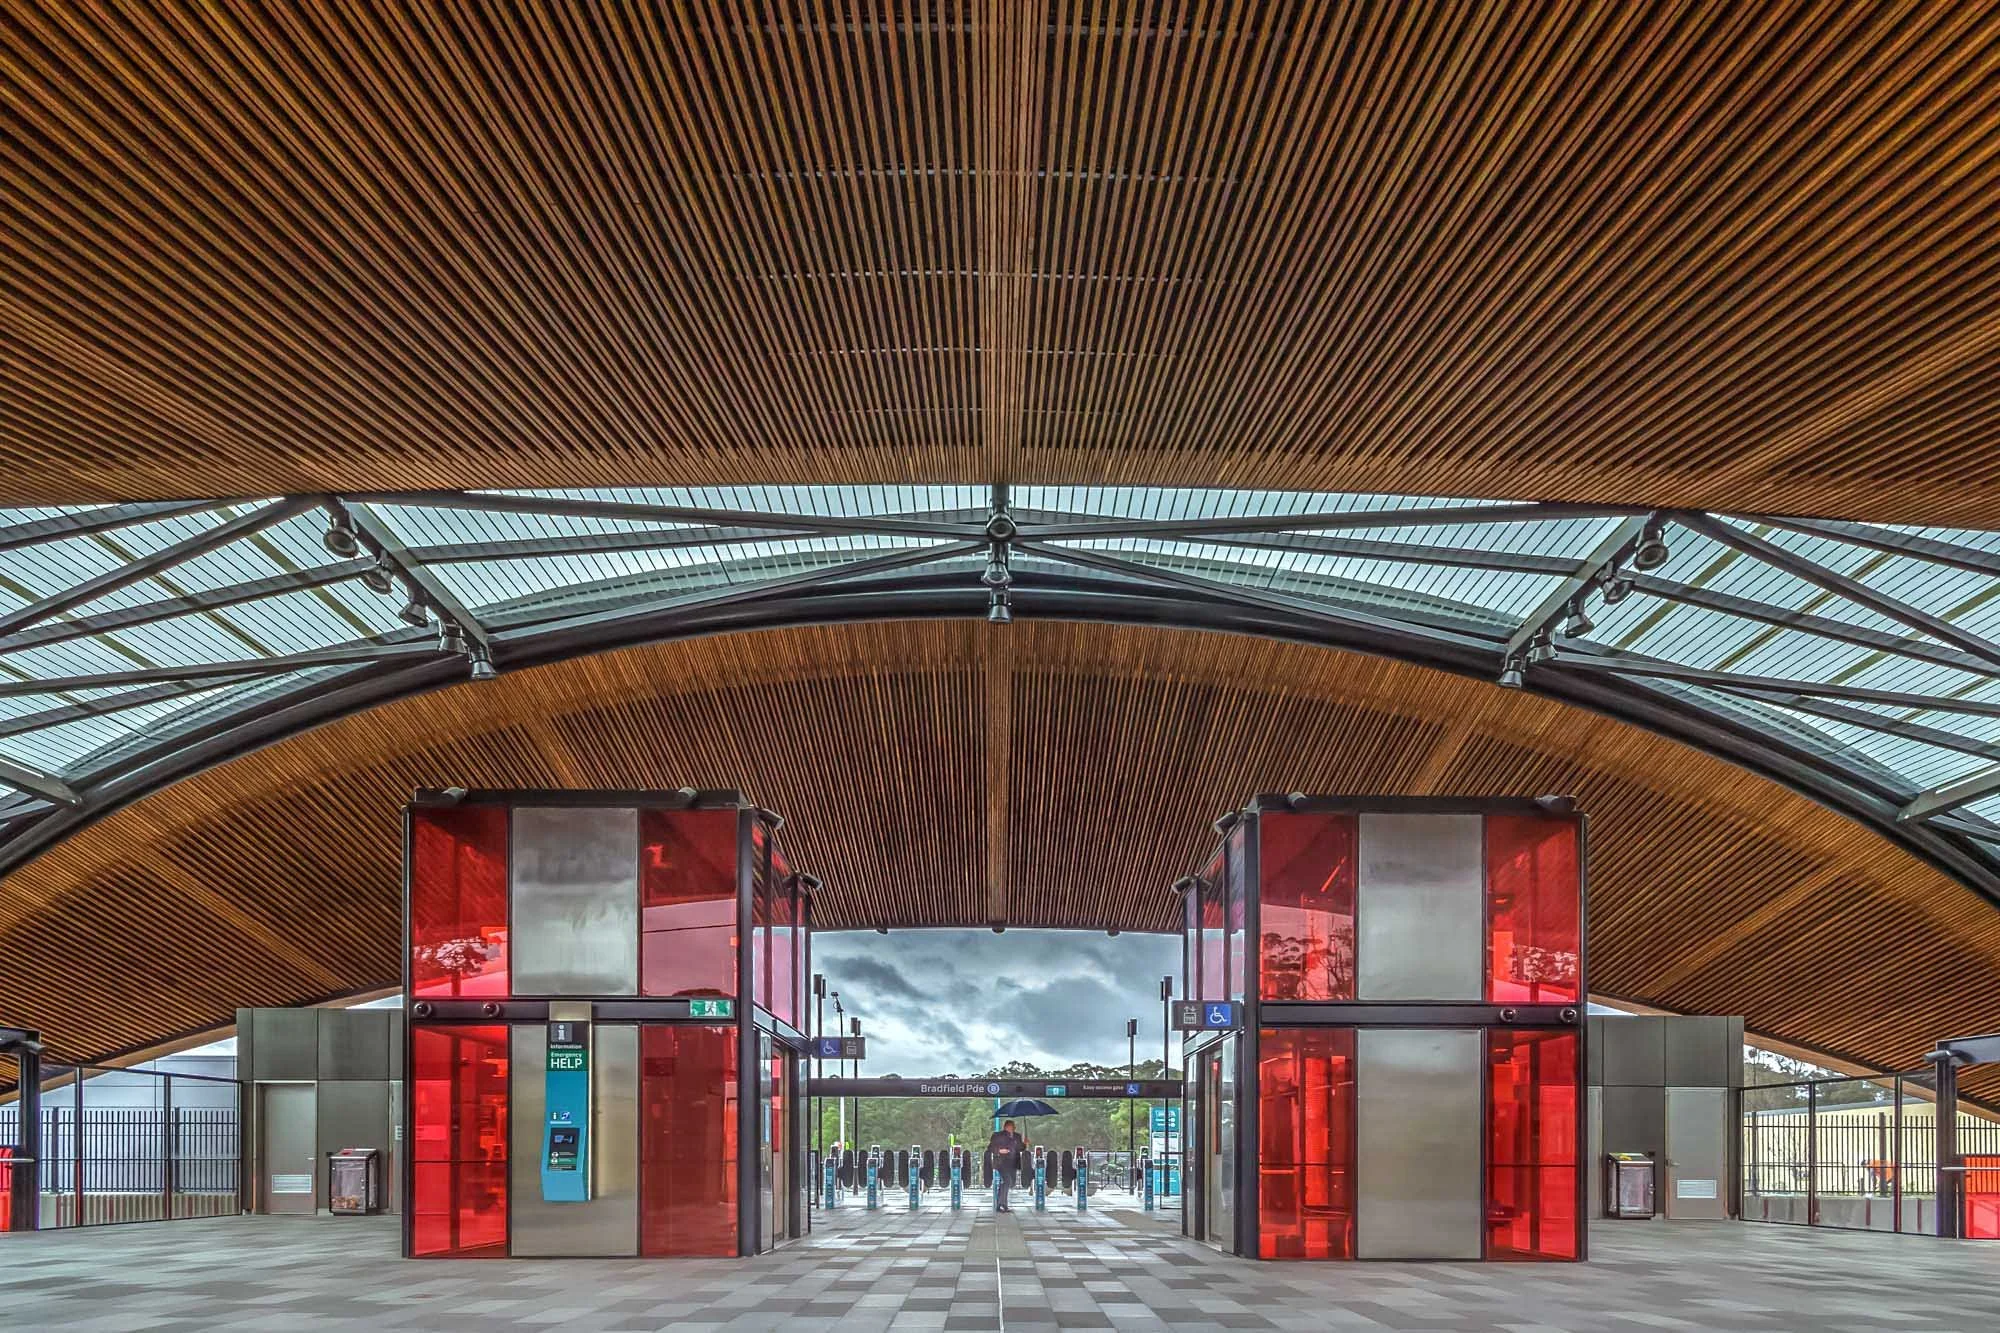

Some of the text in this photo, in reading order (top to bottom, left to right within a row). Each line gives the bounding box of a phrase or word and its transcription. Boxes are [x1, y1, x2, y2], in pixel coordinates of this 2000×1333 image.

[550, 1058, 583, 1069] HELP
[920, 1084, 965, 1093] Bradfield
[966, 1084, 985, 1093] Pde
